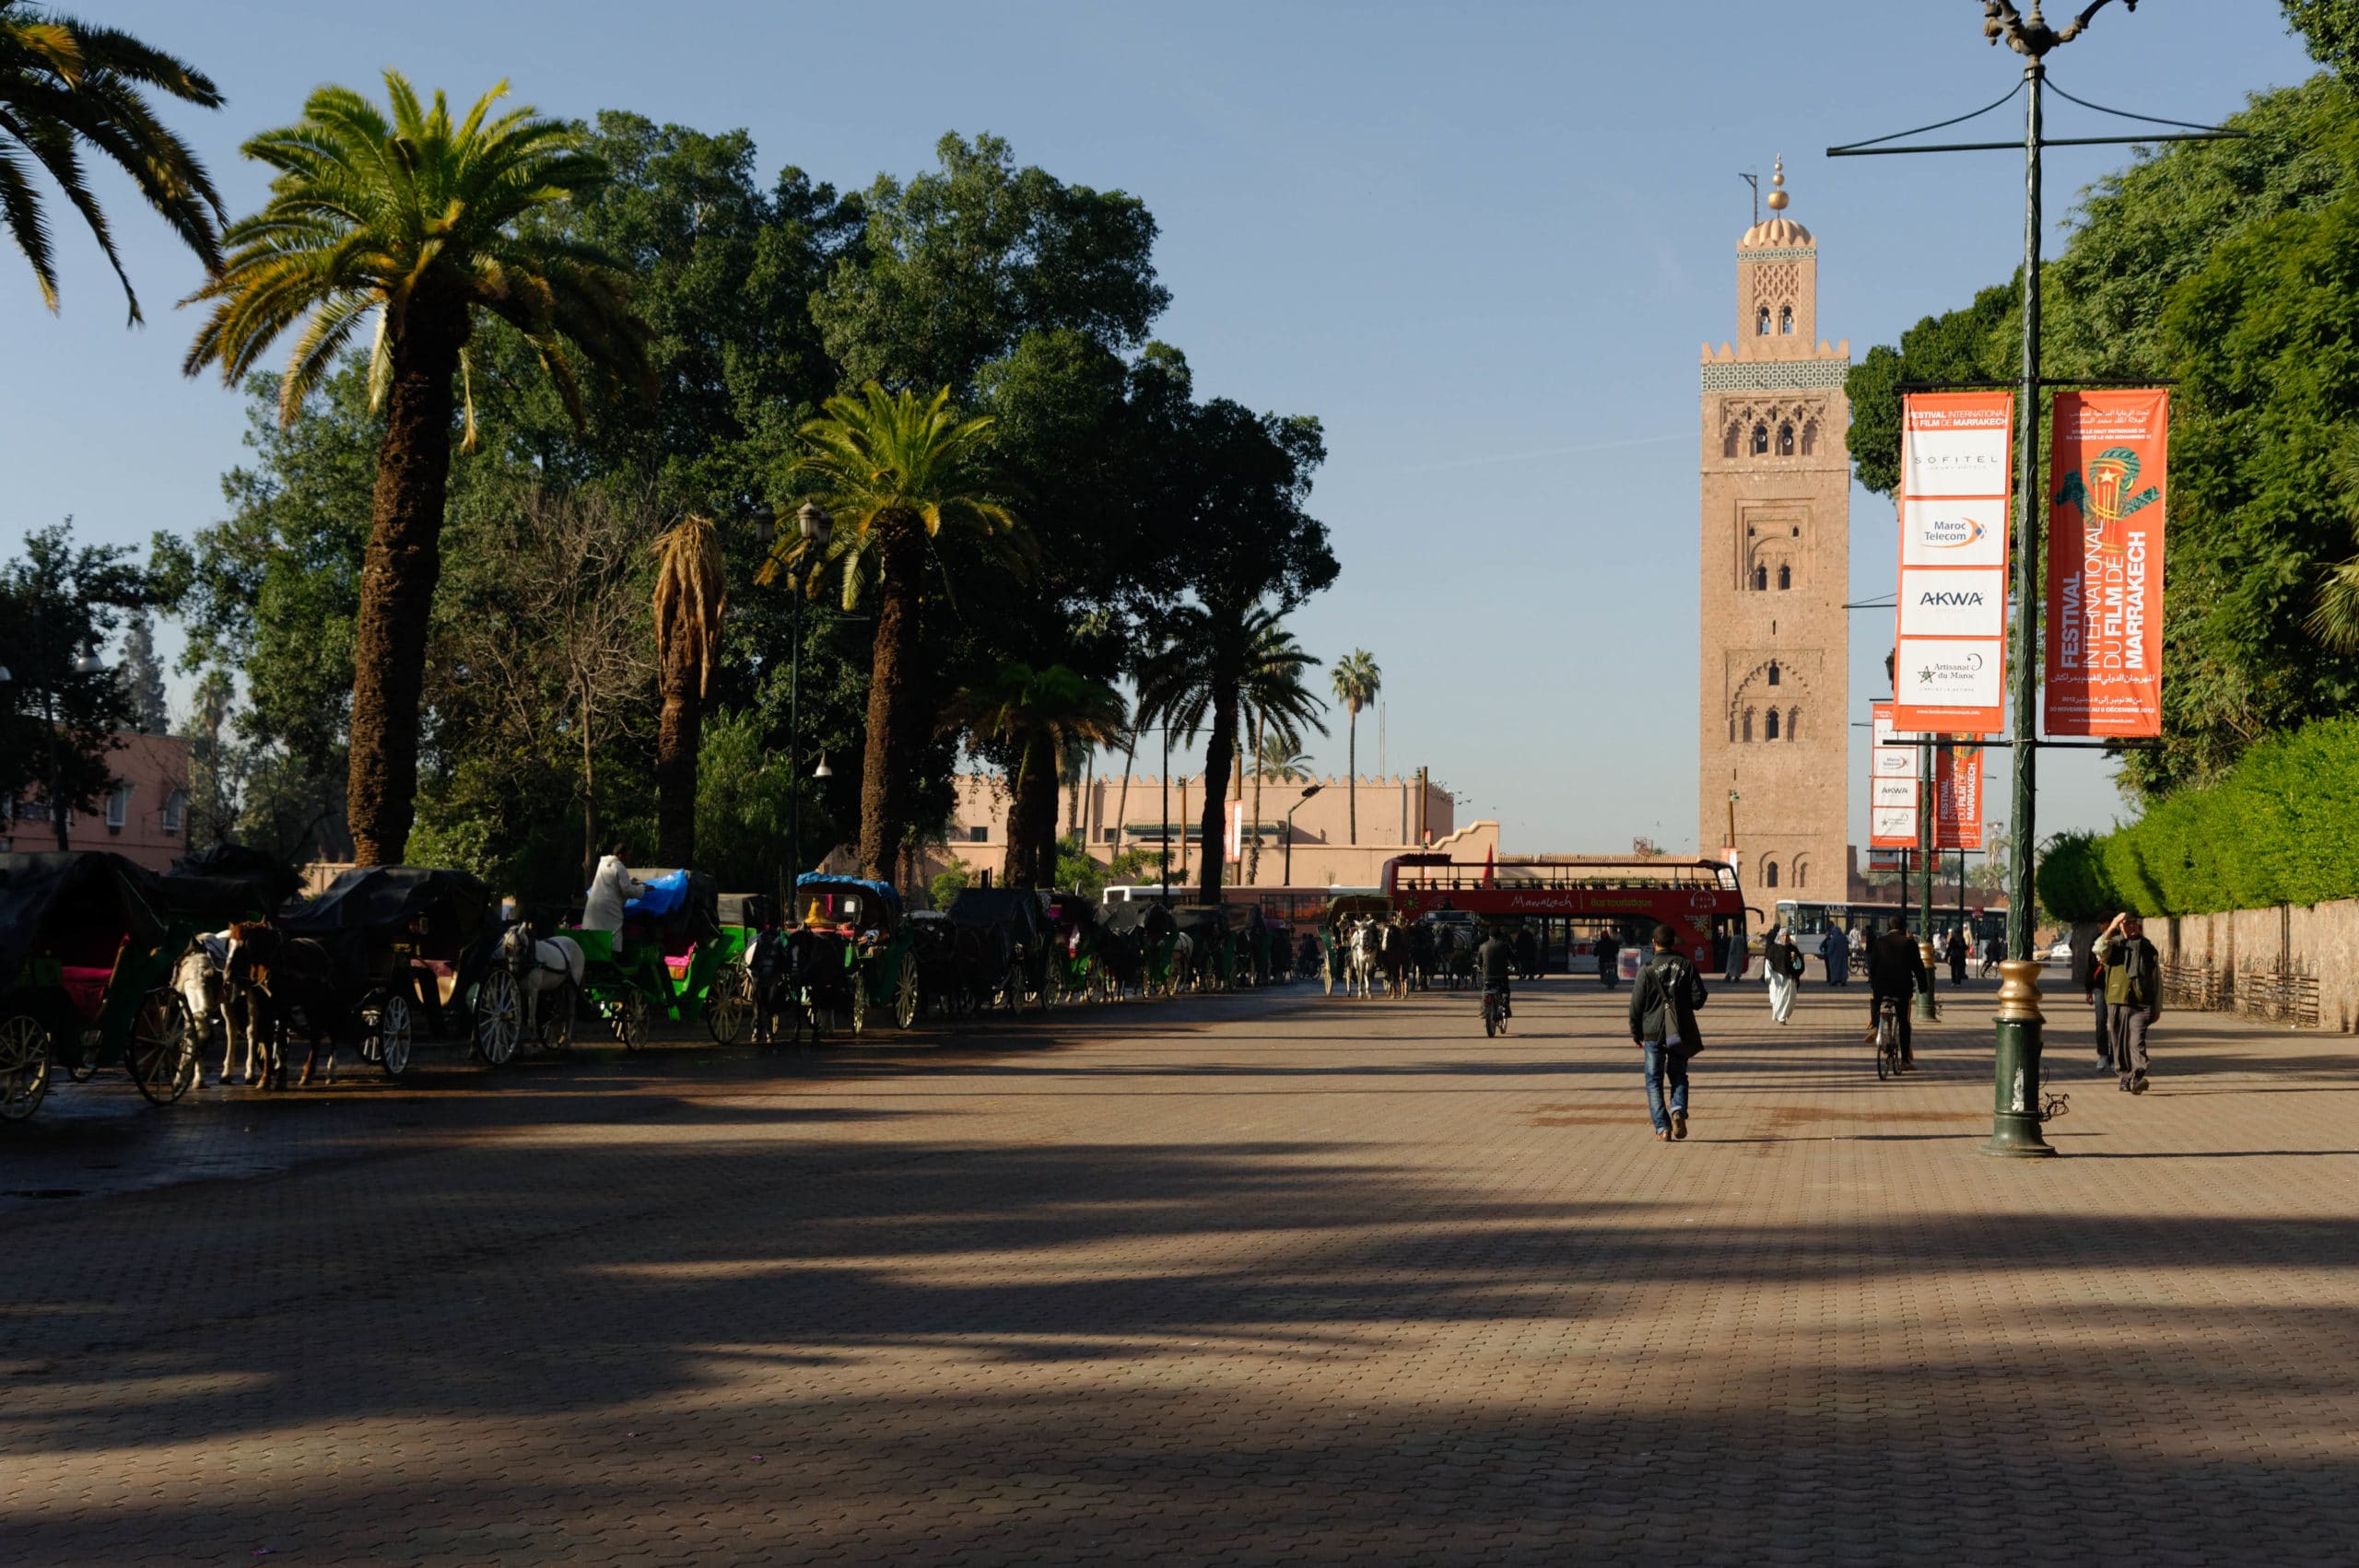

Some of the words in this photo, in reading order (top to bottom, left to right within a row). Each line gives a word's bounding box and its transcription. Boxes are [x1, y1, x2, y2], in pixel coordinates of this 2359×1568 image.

[1910, 411, 1945, 419] FESTIVAL
[1948, 410, 2006, 418] INTERNATIONAL
[1915, 455, 1999, 464] SOFITEL
[1924, 532, 1966, 540] Telecom
[1934, 521, 1966, 530] Maroc
[2106, 556, 2124, 582] DE
[1919, 592, 1984, 605] AKWA
[2083, 520, 2104, 668] INTERNATIONAL
[2125, 532, 2146, 669] MARRAKECH
[2061, 570, 2080, 668] FESTIVAL
[2104, 587, 2123, 637] FILM
[2104, 641, 2122, 669] DU
[1966, 763, 1976, 821] MARRAKECH
